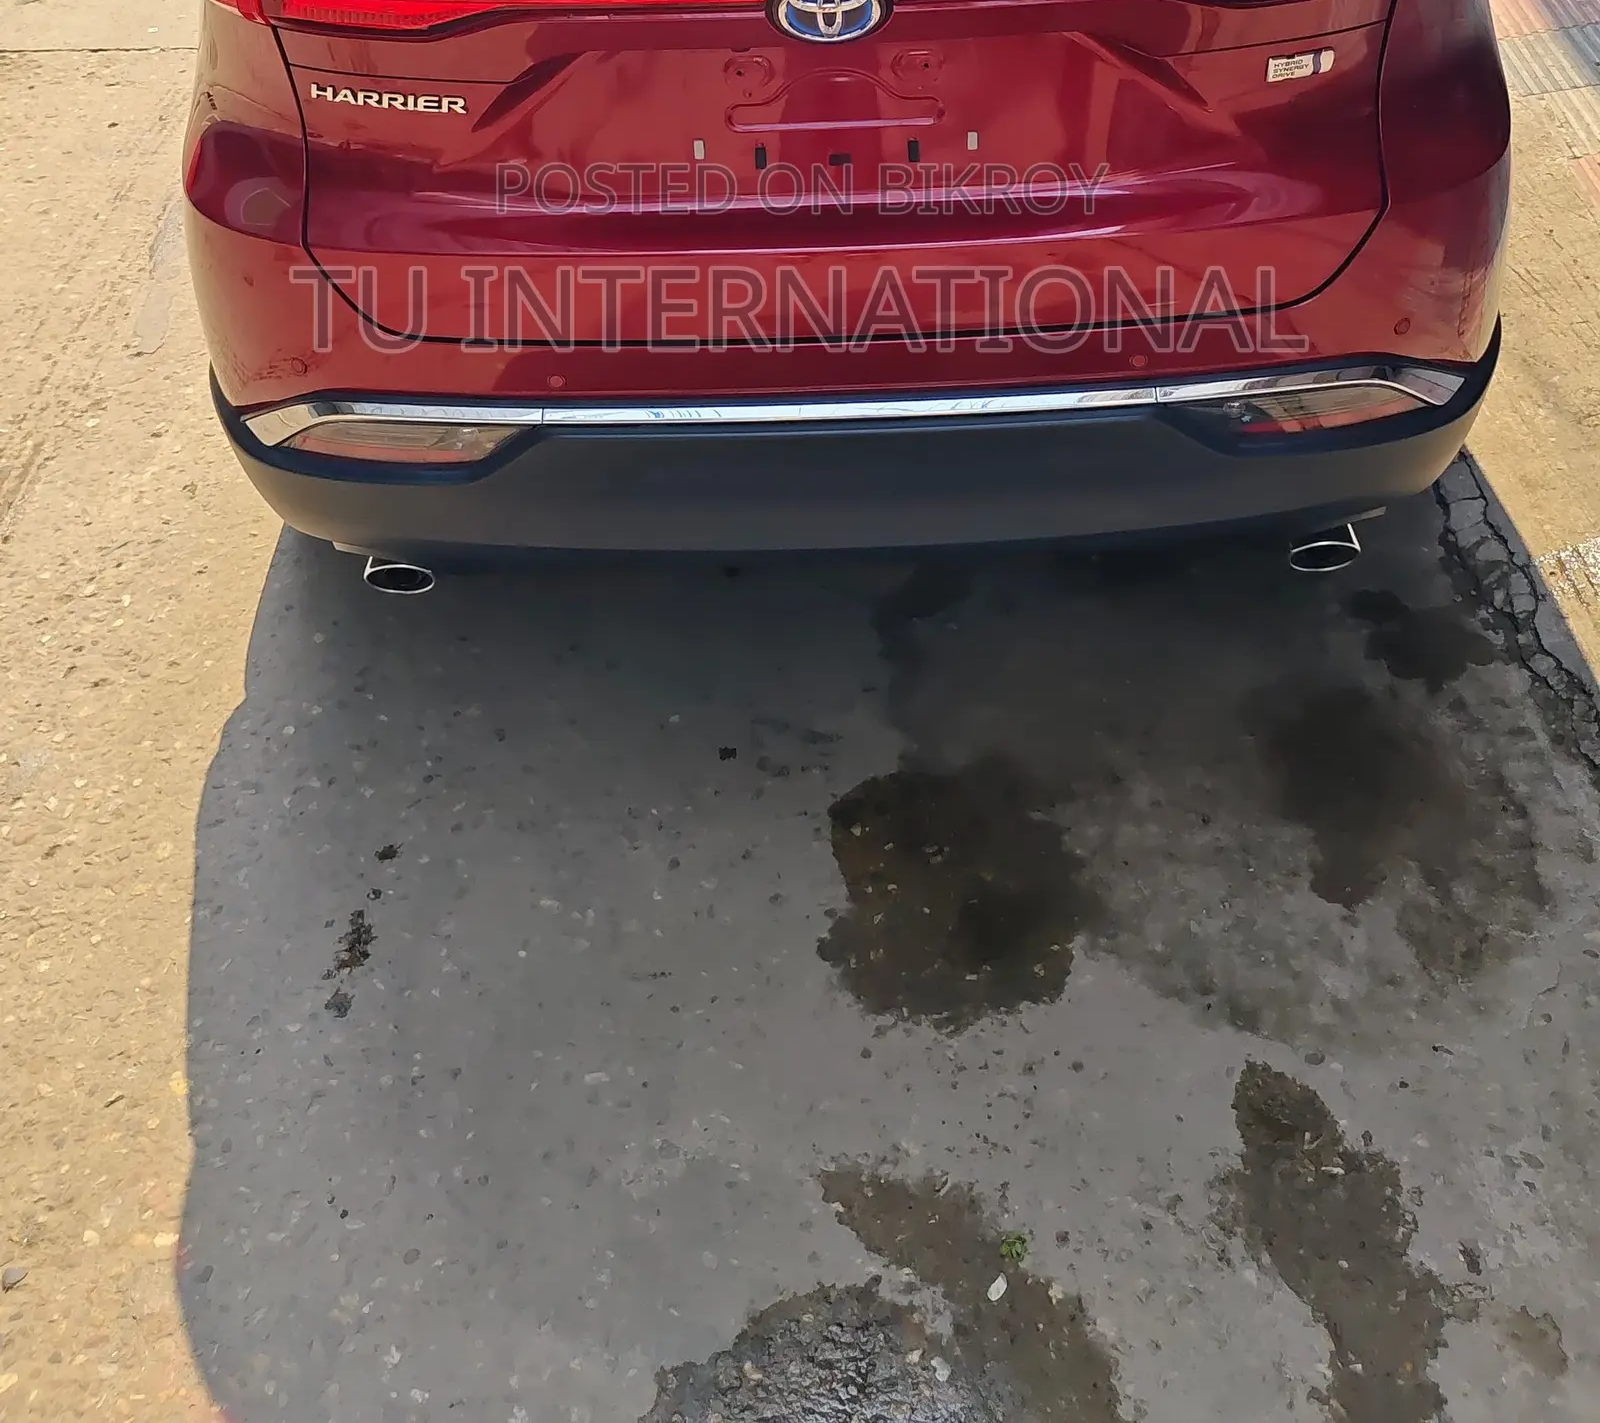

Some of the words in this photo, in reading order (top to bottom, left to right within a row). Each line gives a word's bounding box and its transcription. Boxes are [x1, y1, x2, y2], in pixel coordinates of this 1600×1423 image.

[1273, 58, 1304, 68] HYBRID
[1273, 63, 1310, 74] SYNERGY
[1271, 71, 1296, 79] DRIVE
[310, 83, 467, 114] HARRIER
